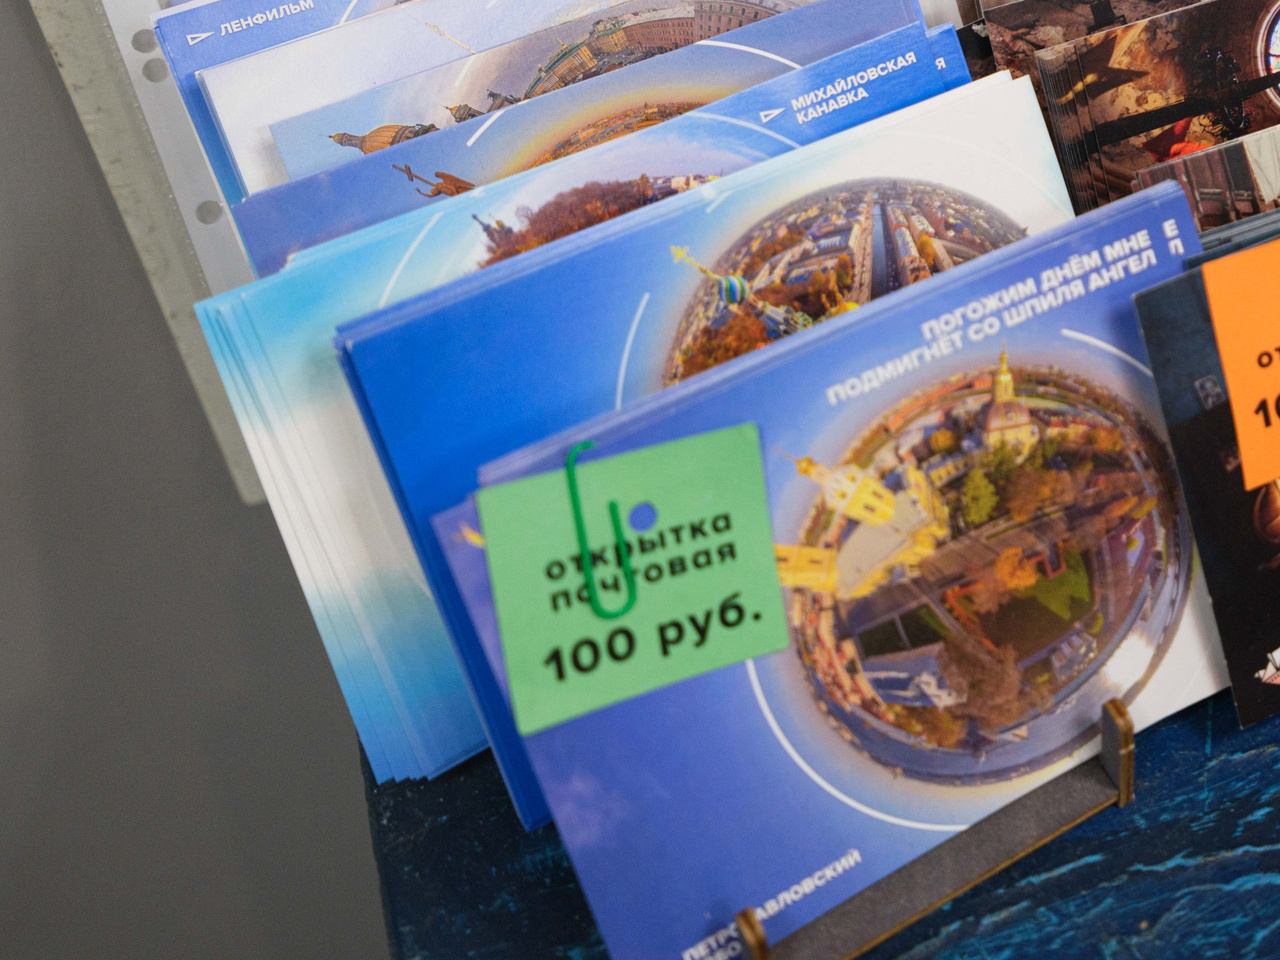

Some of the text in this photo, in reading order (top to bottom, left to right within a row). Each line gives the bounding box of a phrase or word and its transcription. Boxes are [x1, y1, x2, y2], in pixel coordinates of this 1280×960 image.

[790, 51, 918, 112] МИХАЙЛОВСКАЯ
[934, 56, 947, 71] Я
[795, 87, 869, 125] КАНАВКА
[1162, 218, 1179, 239] Е
[920, 228, 1153, 342] ПОГОЖИМ ДНЁМ МНЕ
[825, 248, 1158, 407] ПОДМИГНЁТ СО ШПИЛЯ АНГЕЛ
[551, 541, 737, 613] почовая
[543, 591, 762, 682] 100 руб.
